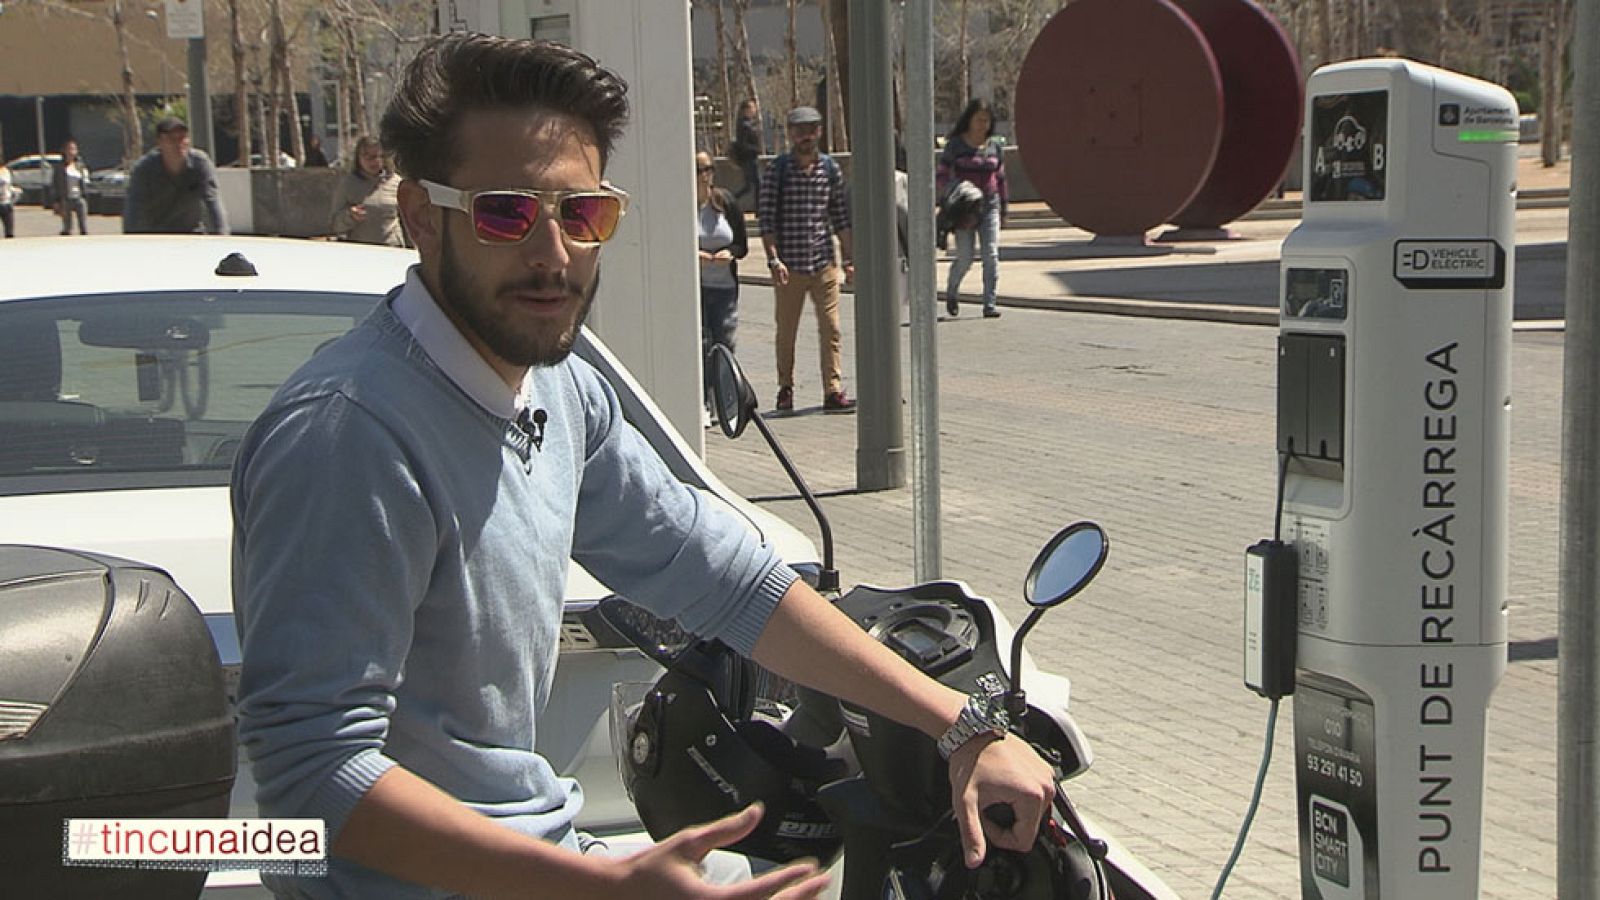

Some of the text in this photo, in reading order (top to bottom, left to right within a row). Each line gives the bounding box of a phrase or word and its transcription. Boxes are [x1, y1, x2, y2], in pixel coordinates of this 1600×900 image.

[1315, 146, 1325, 174] A
[1373, 143, 1384, 171] B
[1431, 248, 1479, 259] VEHICLE
[1411, 341, 1459, 873] PUNT DE RECÀRREGA
[1307, 753, 1319, 772] 93
[1337, 763, 1349, 782] 41
[1349, 768, 1363, 788] 50
[1315, 809, 1338, 835] BCN
[1315, 832, 1346, 860] SMART
[1315, 851, 1338, 876] CITY
